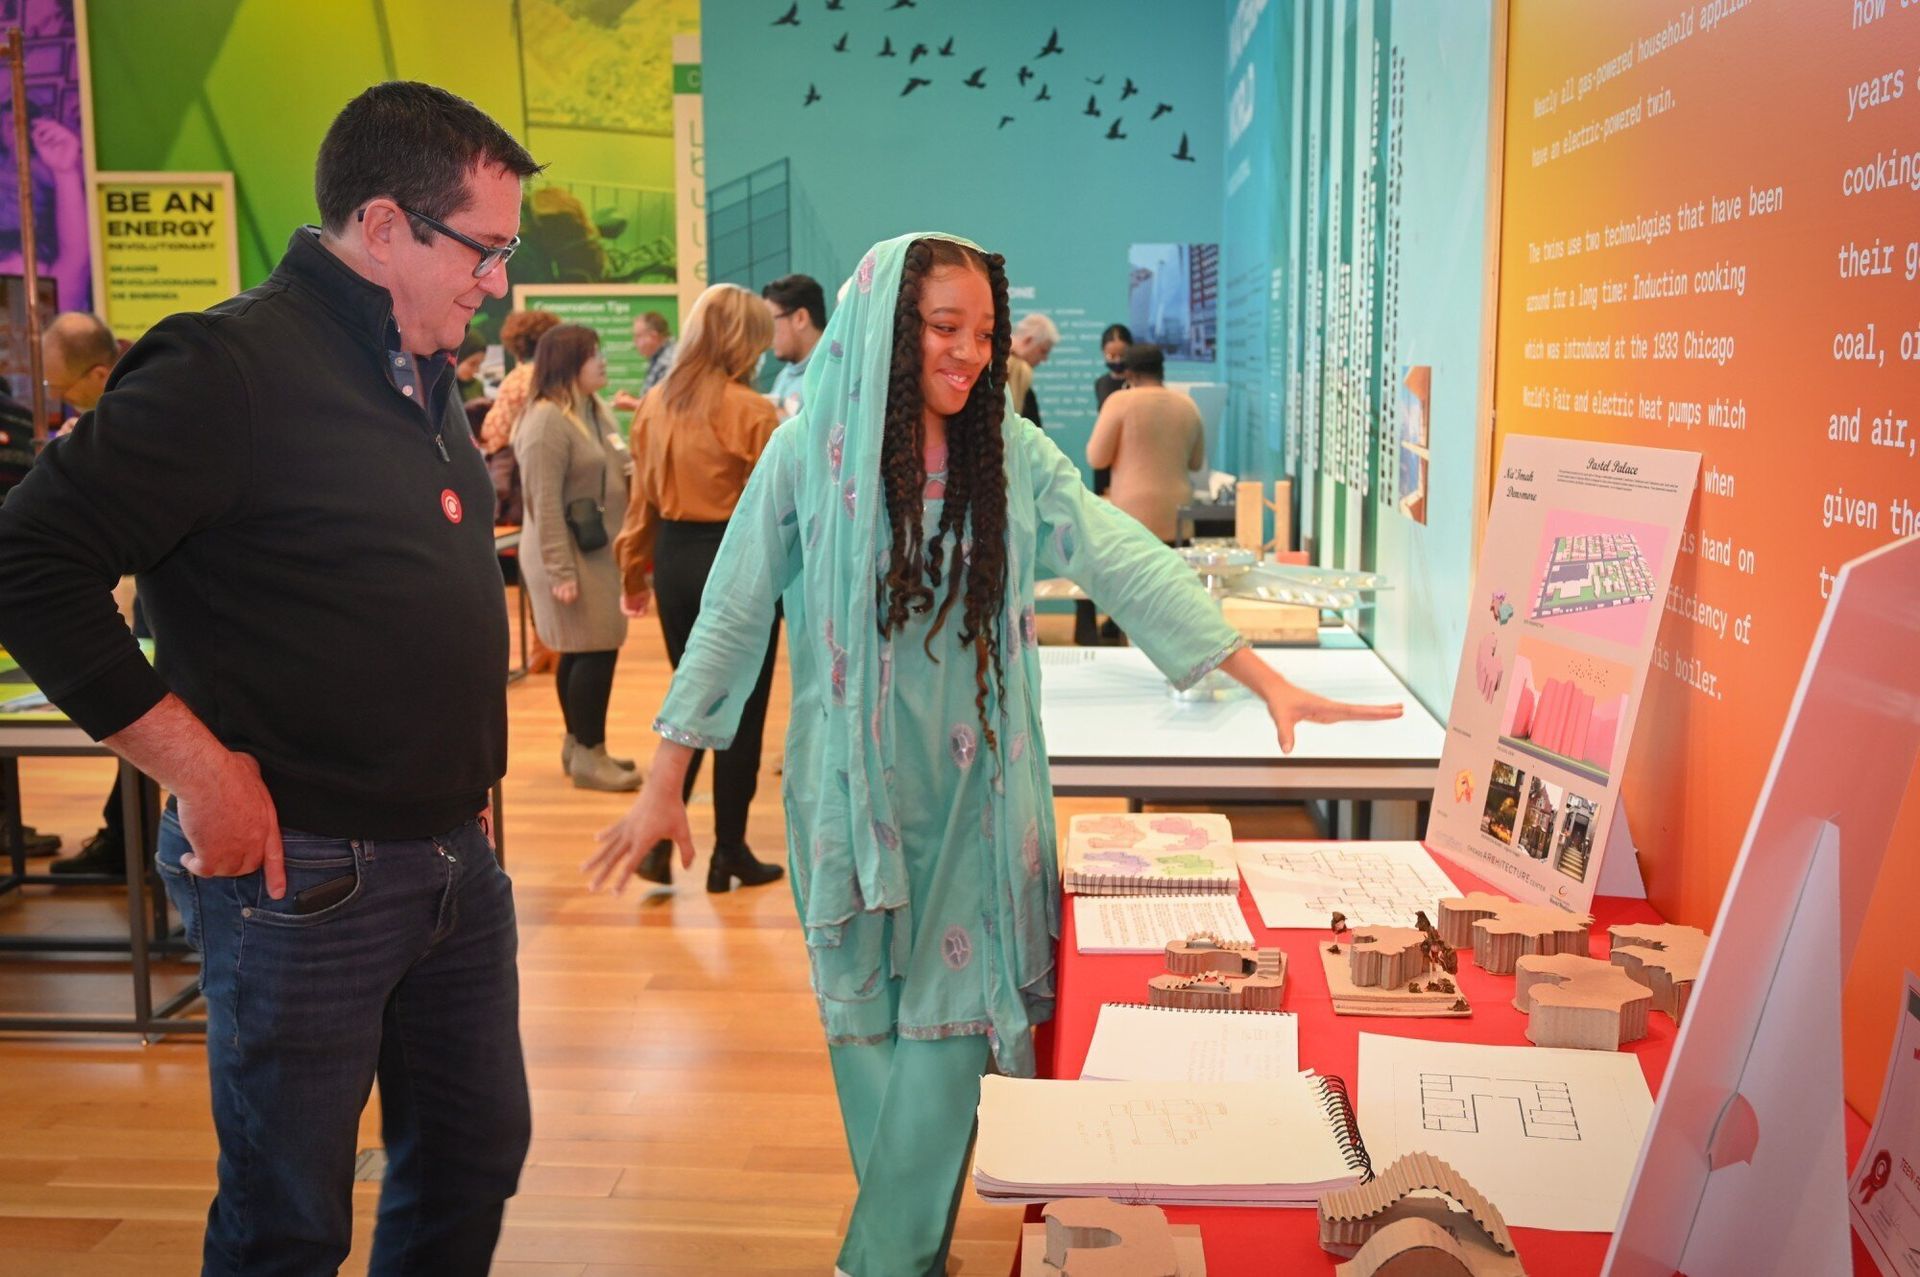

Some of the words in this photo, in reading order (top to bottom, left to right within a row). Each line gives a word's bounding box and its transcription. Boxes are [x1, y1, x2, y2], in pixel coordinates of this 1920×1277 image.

[1534, 89, 1558, 118] Nearly
[1561, 77, 1574, 104] all
[1578, 43, 1634, 101] gas-powered
[1638, 7, 1695, 62] household
[1847, 68, 1904, 122] years
[1531, 146, 1548, 168] have
[1551, 141, 1560, 160] an
[1563, 97, 1642, 154] electric-powered
[1647, 87, 1676, 118] twin.
[1843, 148, 1920, 196] cooking
[106, 191, 151, 213] BE
[164, 191, 214, 213] AN
[1528, 243, 1540, 264] The
[1544, 238, 1564, 260] twins
[1568, 236, 1582, 256] use
[1585, 231, 1600, 251] two
[1604, 210, 1671, 248] technologies
[1677, 201, 1705, 232] that
[1711, 195, 1741, 224] have
[1749, 185, 1783, 217] been
[108, 221, 213, 236] ENERGY
[1838, 238, 1895, 279] their
[1905, 242, 1920, 280] g
[607, 301, 630, 315] Tips
[1526, 289, 1551, 313] around
[1553, 286, 1566, 309] for
[1569, 291, 1576, 307] a
[1578, 283, 1598, 311] long
[1602, 279, 1628, 304] time:
[1633, 269, 1688, 300] Induction
[1694, 260, 1746, 296] cooking
[1524, 337, 1544, 360] which
[1547, 342, 1560, 360] was
[1563, 335, 1611, 360] introduced
[1615, 338, 1626, 360] at
[1631, 333, 1648, 360] the
[1653, 331, 1679, 360] 1933
[1684, 330, 1734, 367] Chicago
[1832, 323, 1885, 368] coal,
[1522, 385, 1551, 409] World's
[1553, 387, 1571, 412] Fair
[1574, 391, 1589, 414] and
[1592, 390, 1634, 418] electric
[1638, 394, 1663, 421] heat
[1668, 401, 1701, 431] pumps
[1708, 397, 1746, 430] which
[1828, 407, 1861, 443] and
[1871, 409, 1915, 456] air,
[1586, 457, 1611, 473] Pastel
[1612, 460, 1639, 476] Palace
[1704, 465, 1735, 498] when
[1823, 487, 1877, 530] given
[1701, 530, 1731, 567] hand
[1738, 547, 1755, 575] on
[1735, 614, 1752, 645] of
[1675, 649, 1723, 700] boiler.
